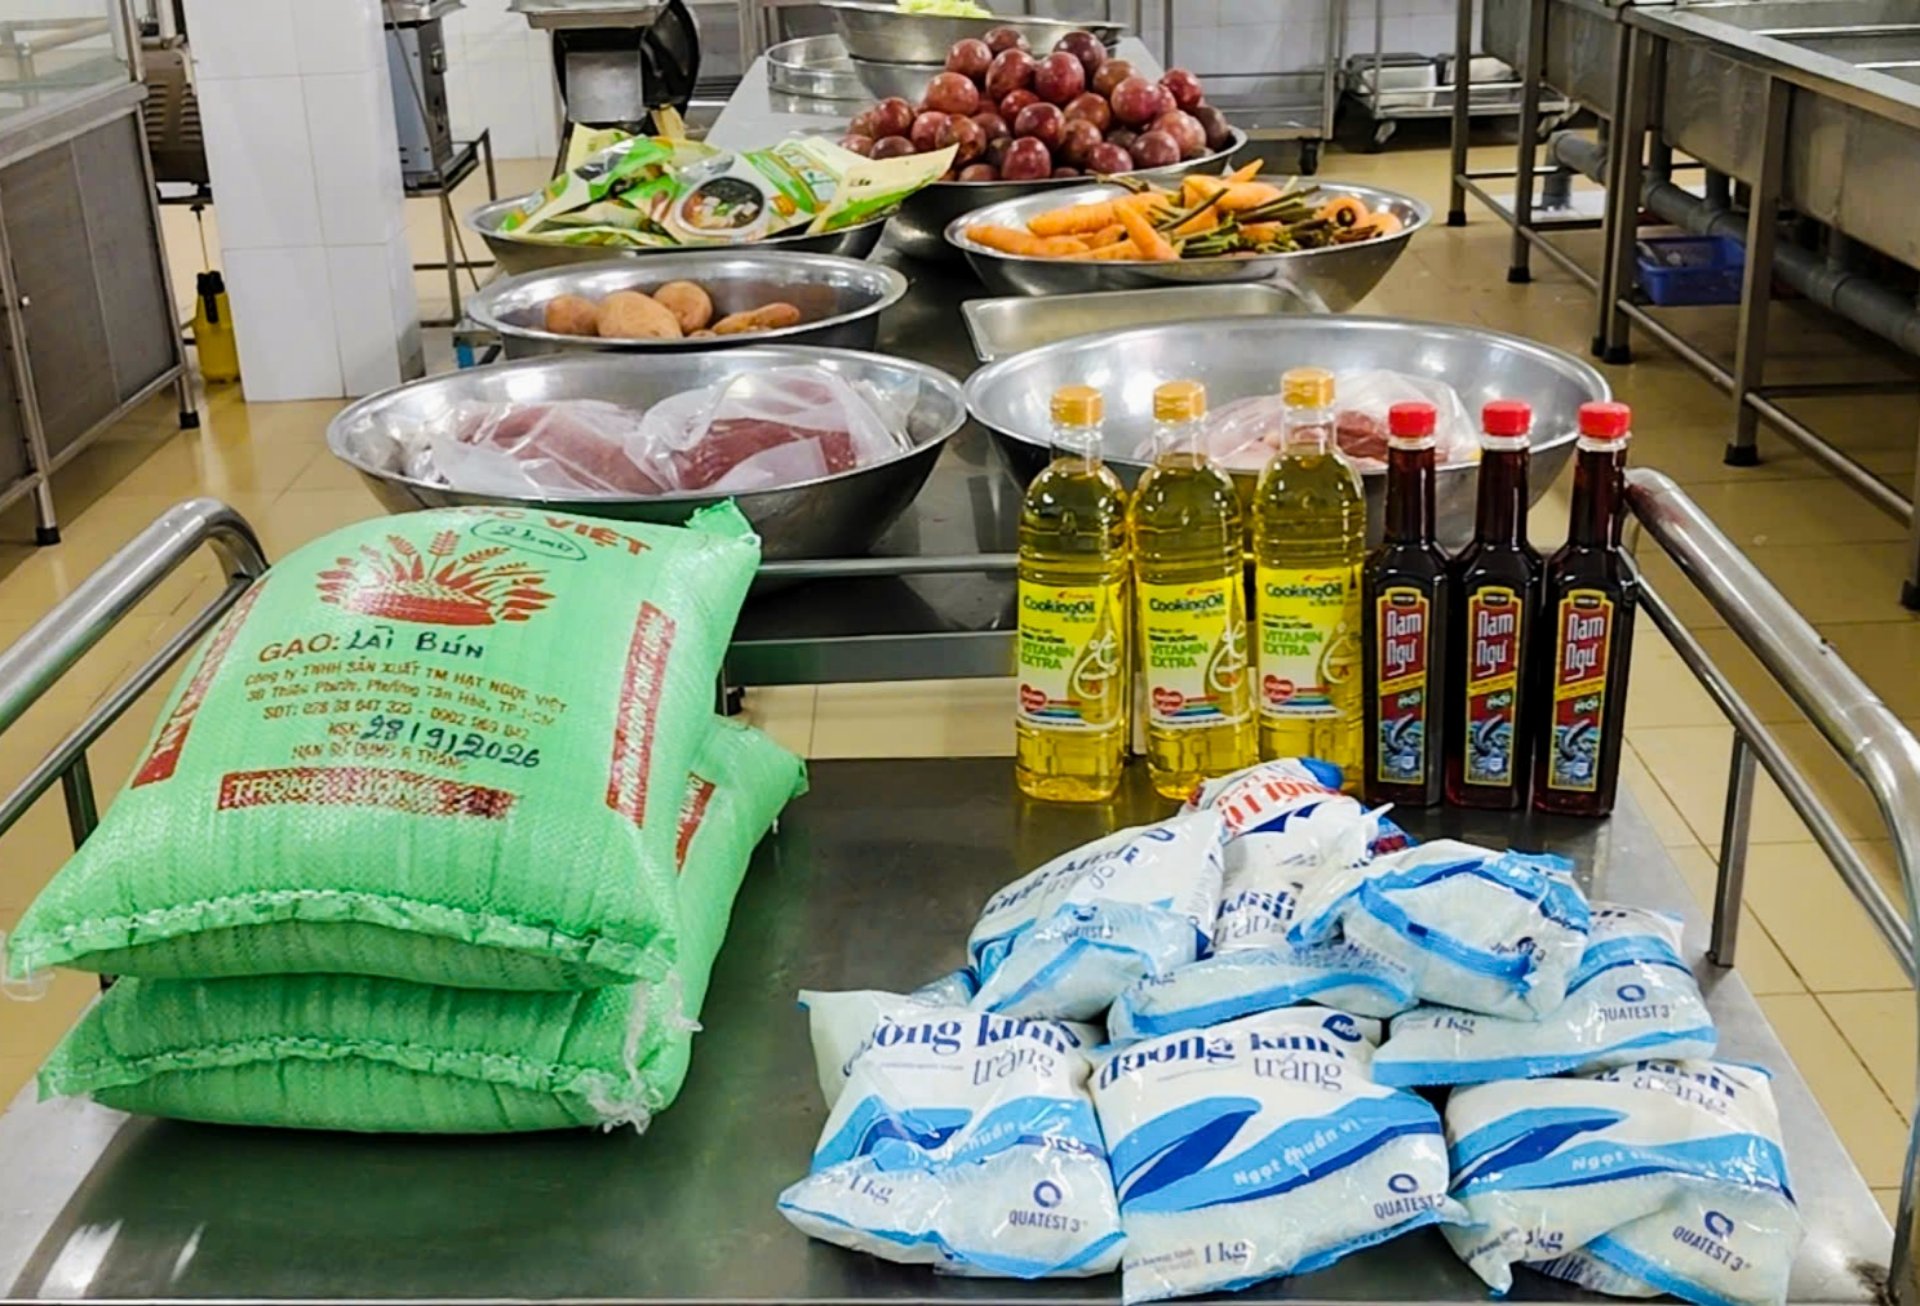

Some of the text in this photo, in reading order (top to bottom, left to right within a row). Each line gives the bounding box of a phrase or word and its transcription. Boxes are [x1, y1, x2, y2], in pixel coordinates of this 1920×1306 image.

[545, 516, 652, 556] VIỆT
[1150, 594, 1224, 611] CookingOil
[1265, 583, 1343, 598] CookingOil
[1023, 595, 1094, 613] CookingOil
[1265, 629, 1322, 643] VITAMIN
[1387, 610, 1422, 637] Nam
[1477, 611, 1513, 637] Nam
[1567, 614, 1604, 640] Nam
[259, 633, 340, 662] GẠO:
[1023, 642, 1075, 657] VITAMIN
[1152, 642, 1208, 655] VITAMIN
[1265, 643, 1310, 656] EXTRA
[1386, 639, 1418, 677] Ngư
[1476, 639, 1507, 678] Ngư
[1022, 656, 1062, 670] EXTRA
[1152, 656, 1197, 669] EXTRA
[1564, 642, 1598, 682] Ngư
[1233, 1158, 1282, 1187] Ngọt
[1572, 1150, 1626, 1175] Ngọt
[1374, 1194, 1434, 1220] QUATEST
[1009, 1209, 1067, 1231] QUATEST
[1204, 1240, 1250, 1265] 1 kg
[1672, 1225, 1730, 1266] QUATEST
